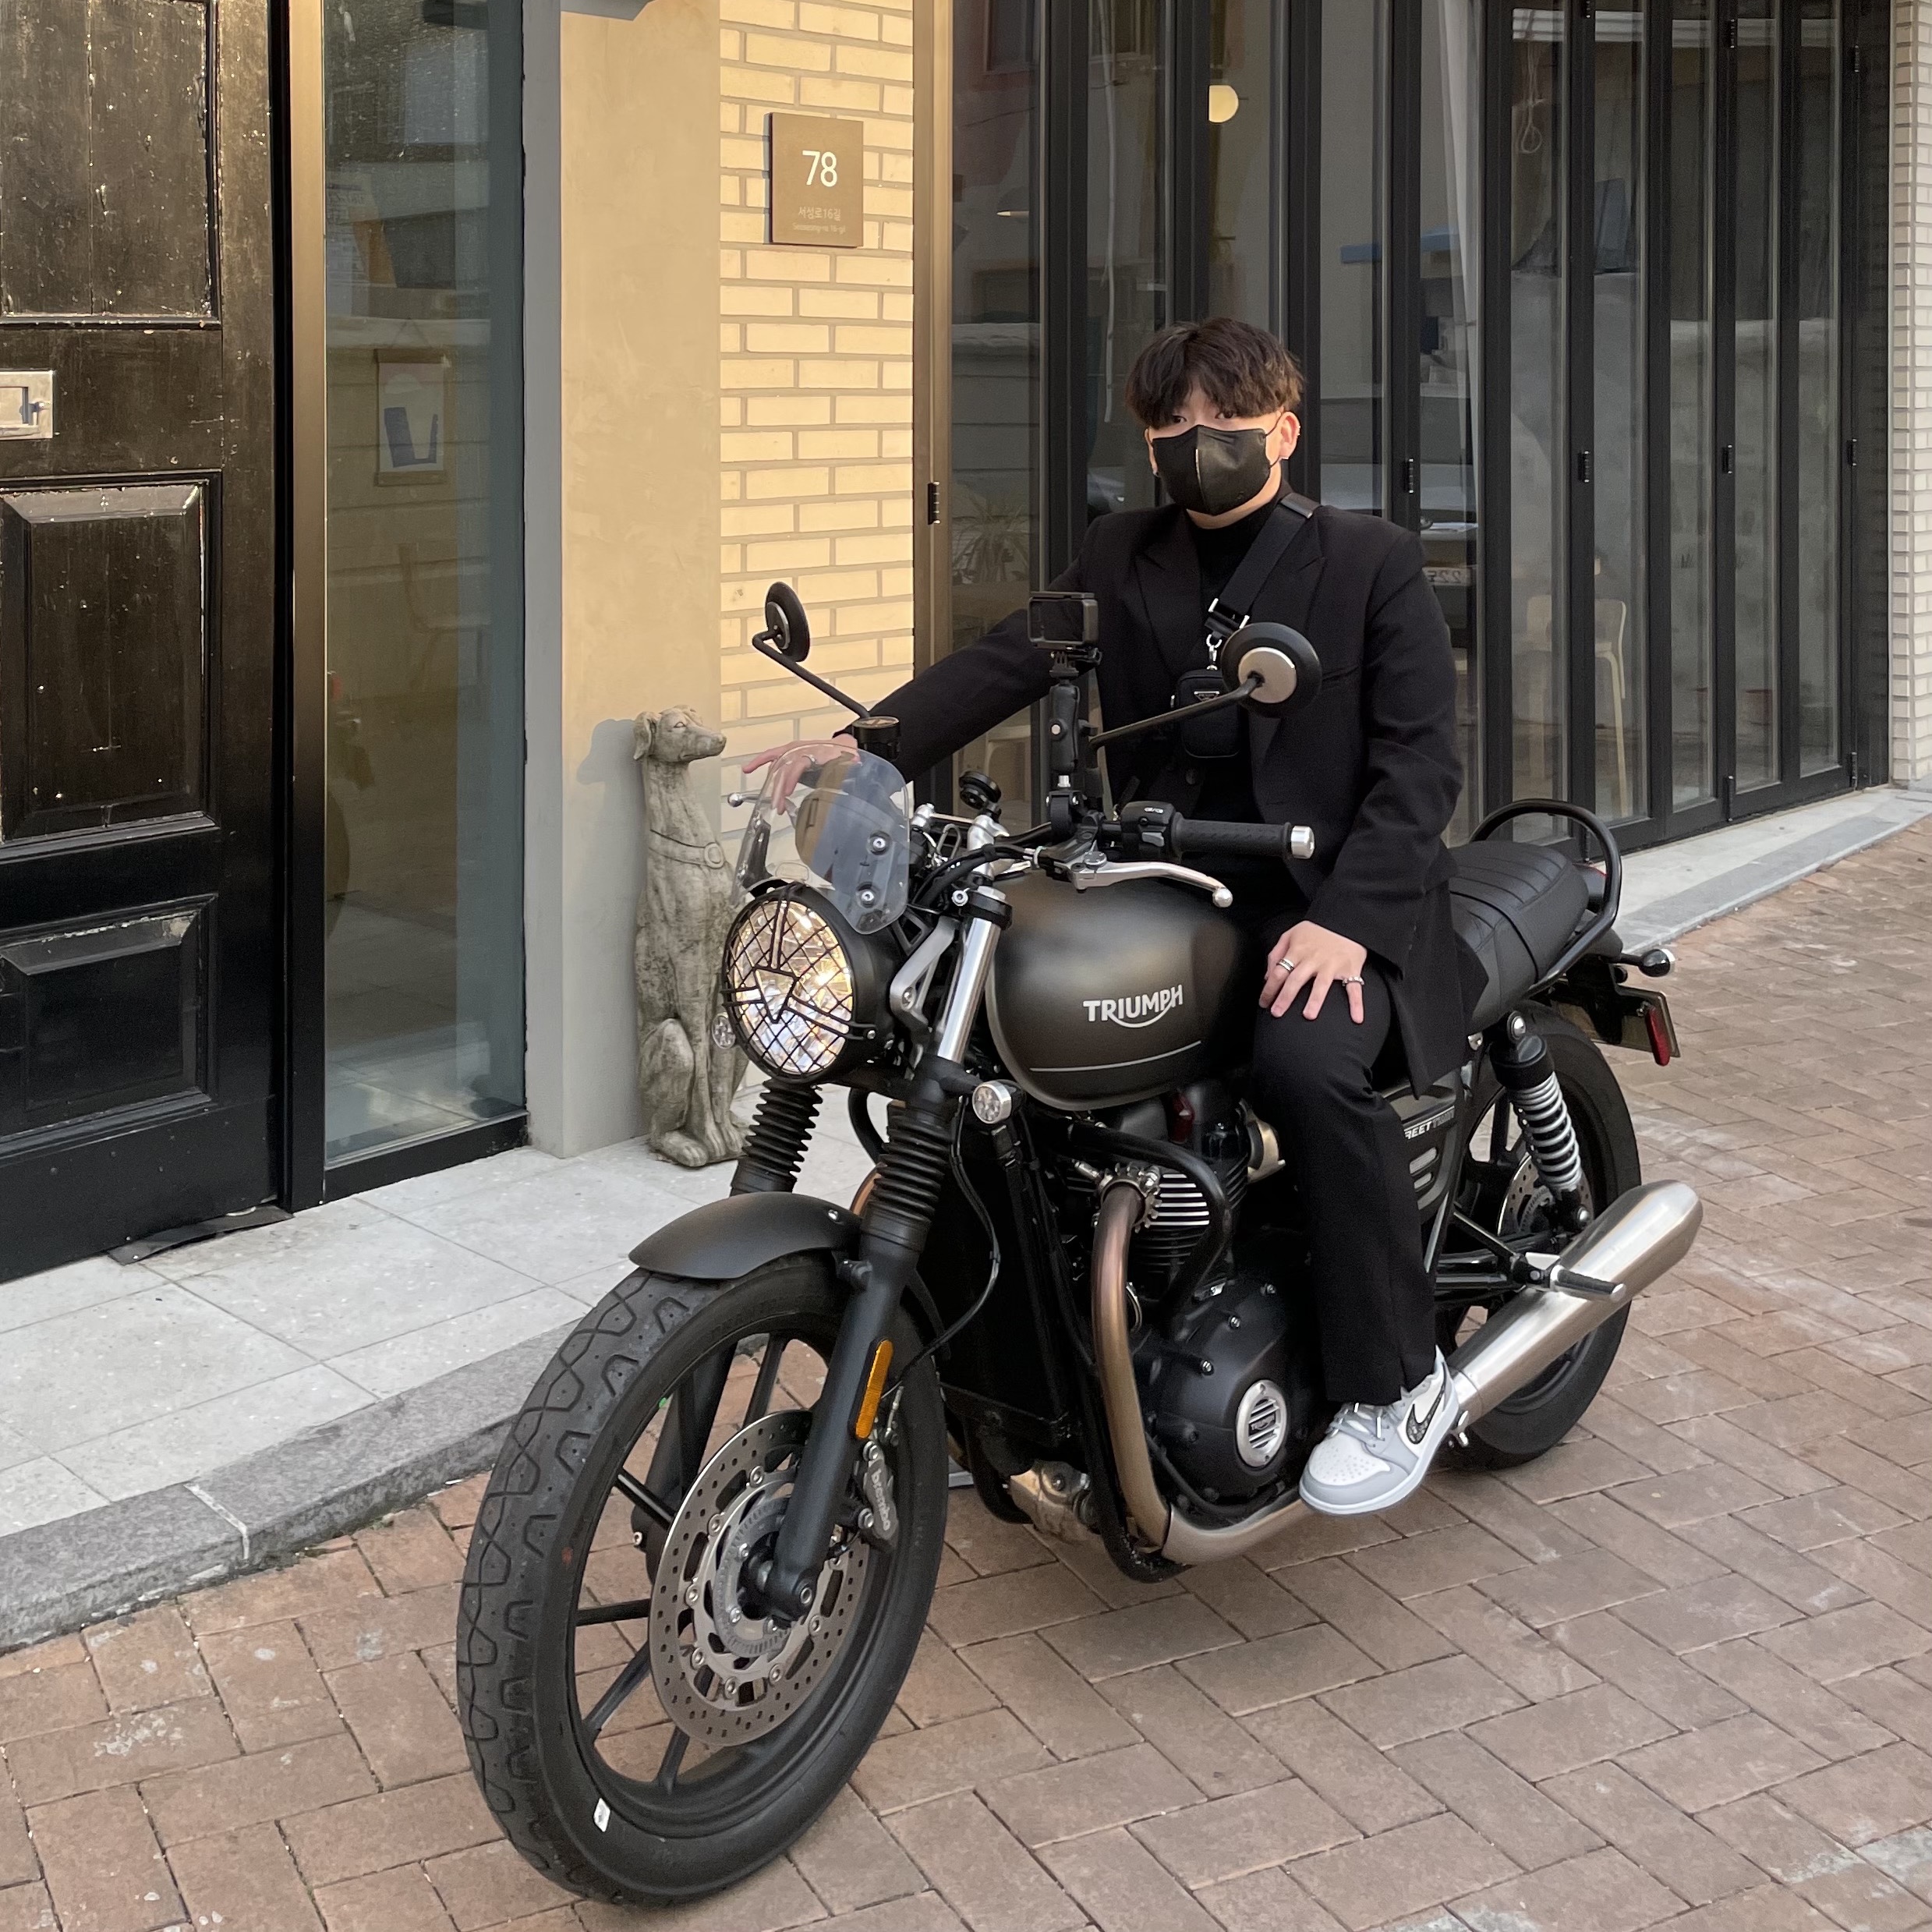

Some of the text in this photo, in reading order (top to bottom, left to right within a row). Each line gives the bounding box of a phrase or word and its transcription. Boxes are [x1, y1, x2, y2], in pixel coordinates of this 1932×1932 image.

[801, 150, 837, 187] 78
[798, 206, 841, 221] 서성로16길
[1082, 984, 1184, 1028] TRIUMPH
[871, 1468, 891, 1531] brembo
